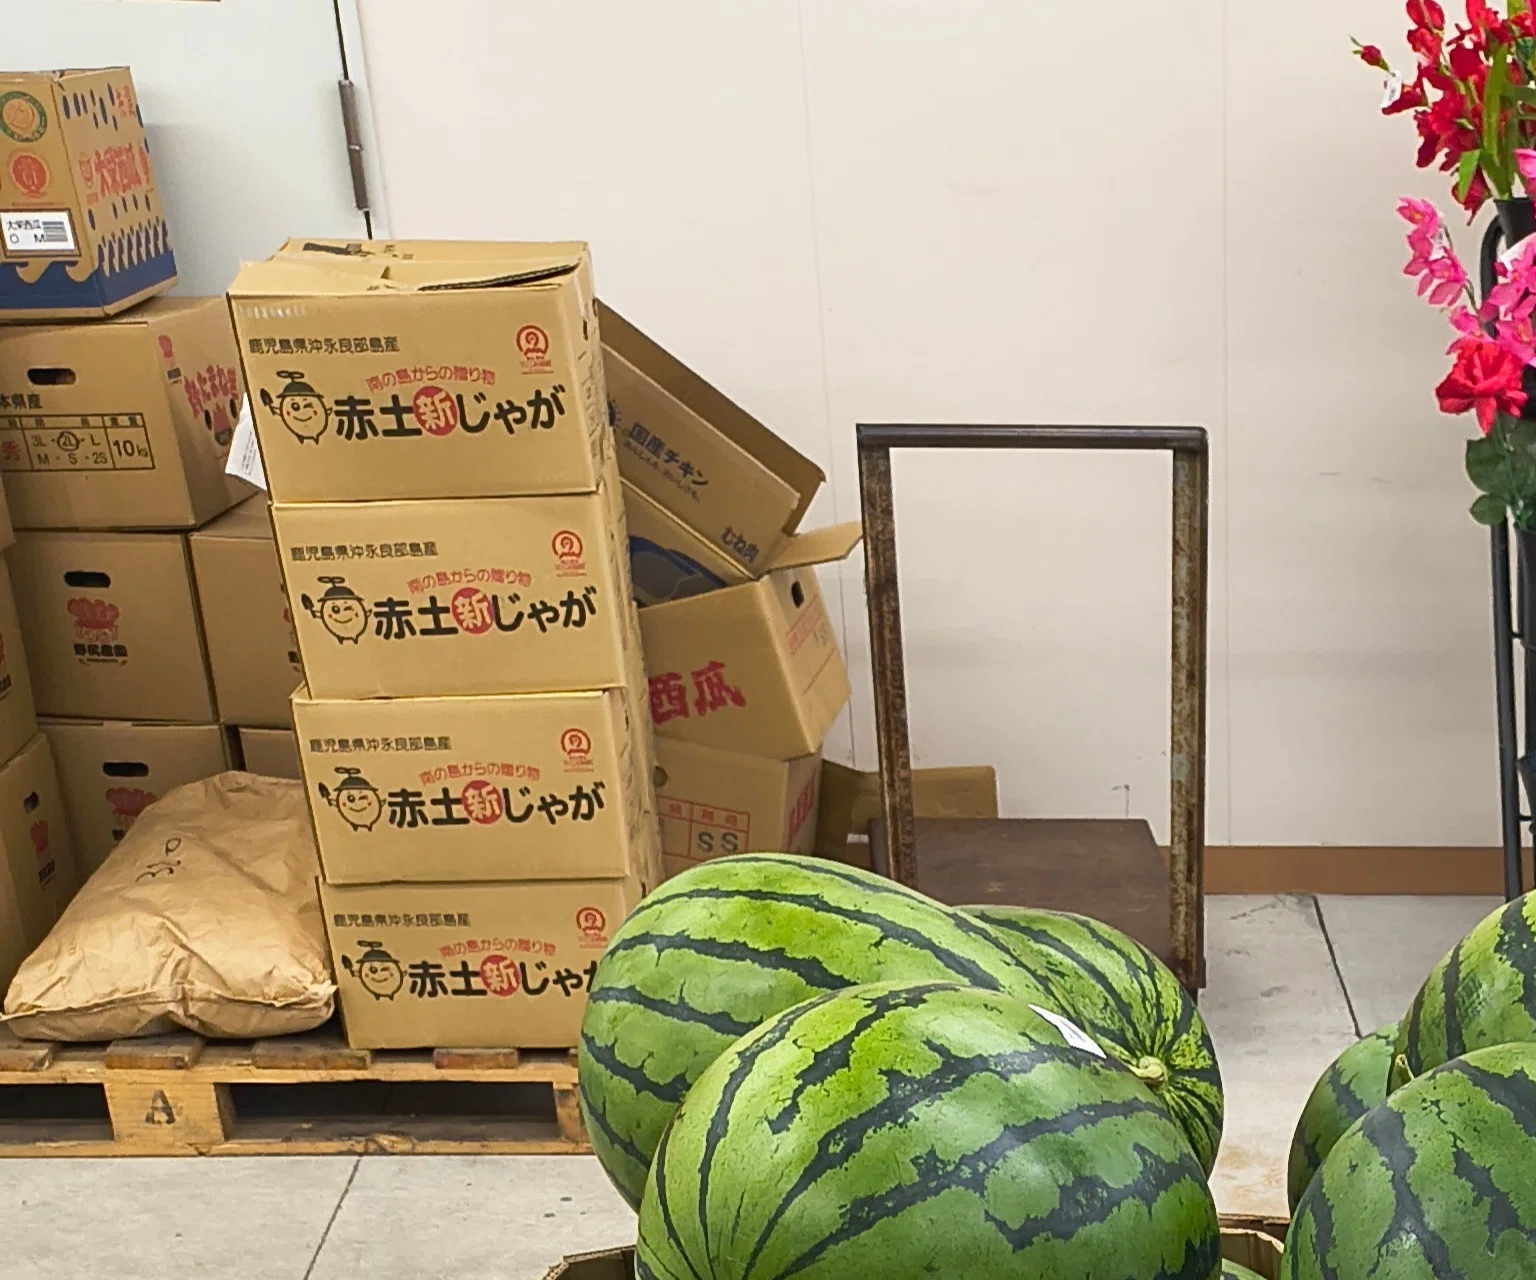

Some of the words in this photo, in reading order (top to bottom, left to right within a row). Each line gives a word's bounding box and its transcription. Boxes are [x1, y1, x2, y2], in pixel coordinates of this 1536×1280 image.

[367, 365, 496, 393] 南の島からの贈り物
[333, 384, 566, 440] 赤土新じゃが
[629, 422, 709, 486] 国産チキン
[407, 569, 532, 594] 南の島からの贈り物
[373, 586, 597, 640] 赤土新じゃが
[647, 660, 747, 726] 西瓜
[388, 780, 606, 828] 赤土新じゃが
[145, 1090, 176, 1125] A
